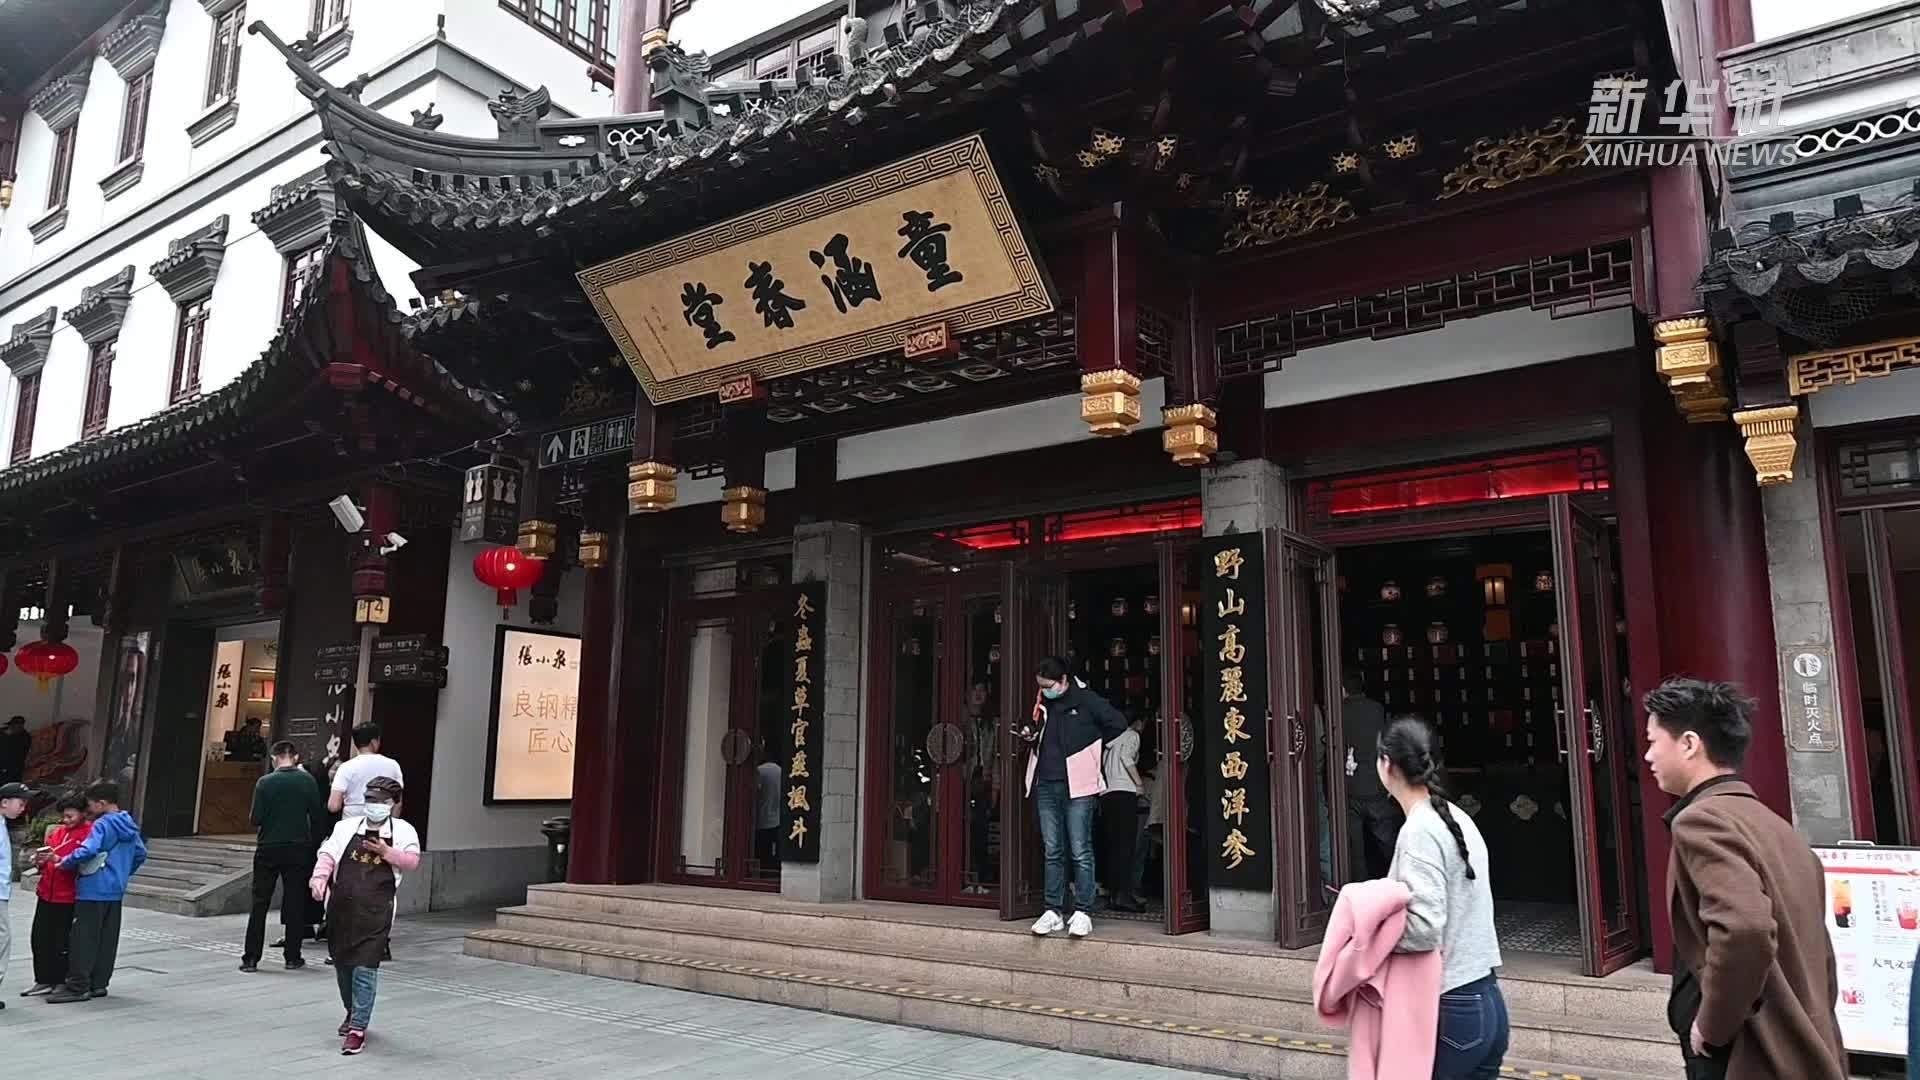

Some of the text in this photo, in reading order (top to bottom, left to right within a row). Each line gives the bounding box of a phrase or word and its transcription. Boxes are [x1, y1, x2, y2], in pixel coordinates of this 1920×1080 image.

[680, 209, 964, 350] 童涵春堂
[528, 728, 574, 753] 匠心
[1802, 682, 1823, 745] 临时灭火点
